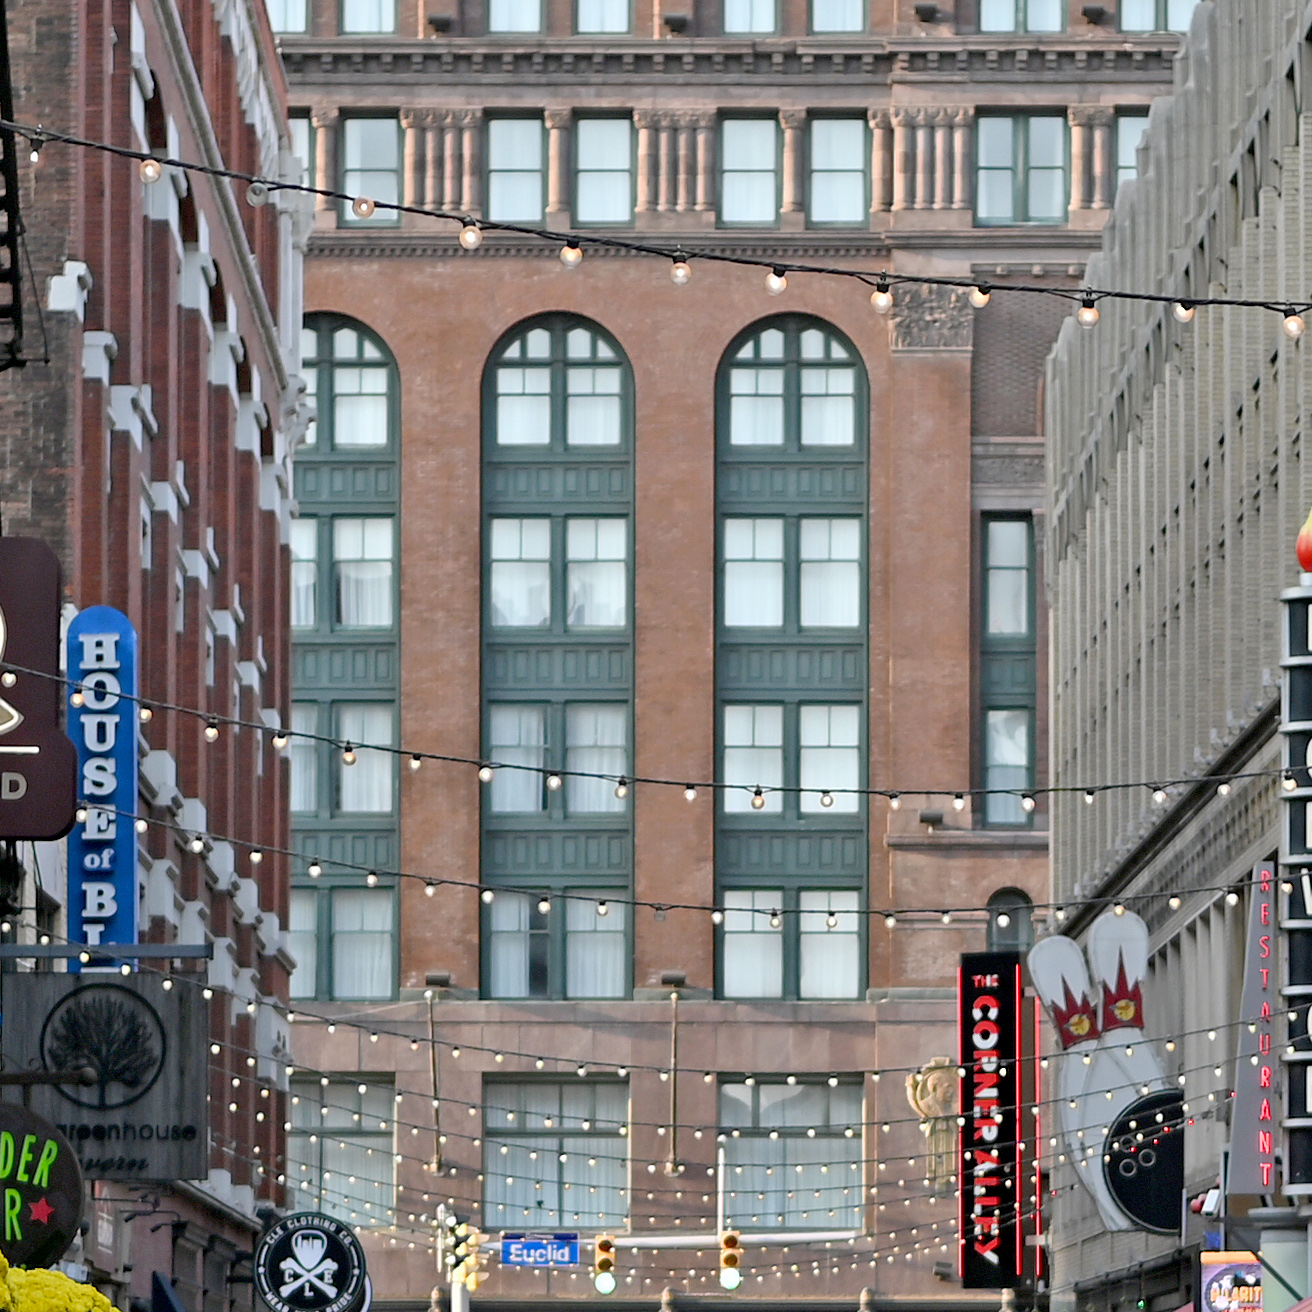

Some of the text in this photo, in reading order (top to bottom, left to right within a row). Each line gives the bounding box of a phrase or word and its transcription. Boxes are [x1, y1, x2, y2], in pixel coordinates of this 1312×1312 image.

[78, 632, 123, 842] HOUSE
[83, 847, 114, 869] of
[972, 974, 999, 987] THE
[1258, 868, 1271, 1188] RESTAURANT
[972, 995, 1001, 1266] CORNER ALLEY
[266, 1226, 284, 1245] CLE
[286, 1216, 338, 1232] CLOTHING
[510, 1243, 569, 1262] Euclid
